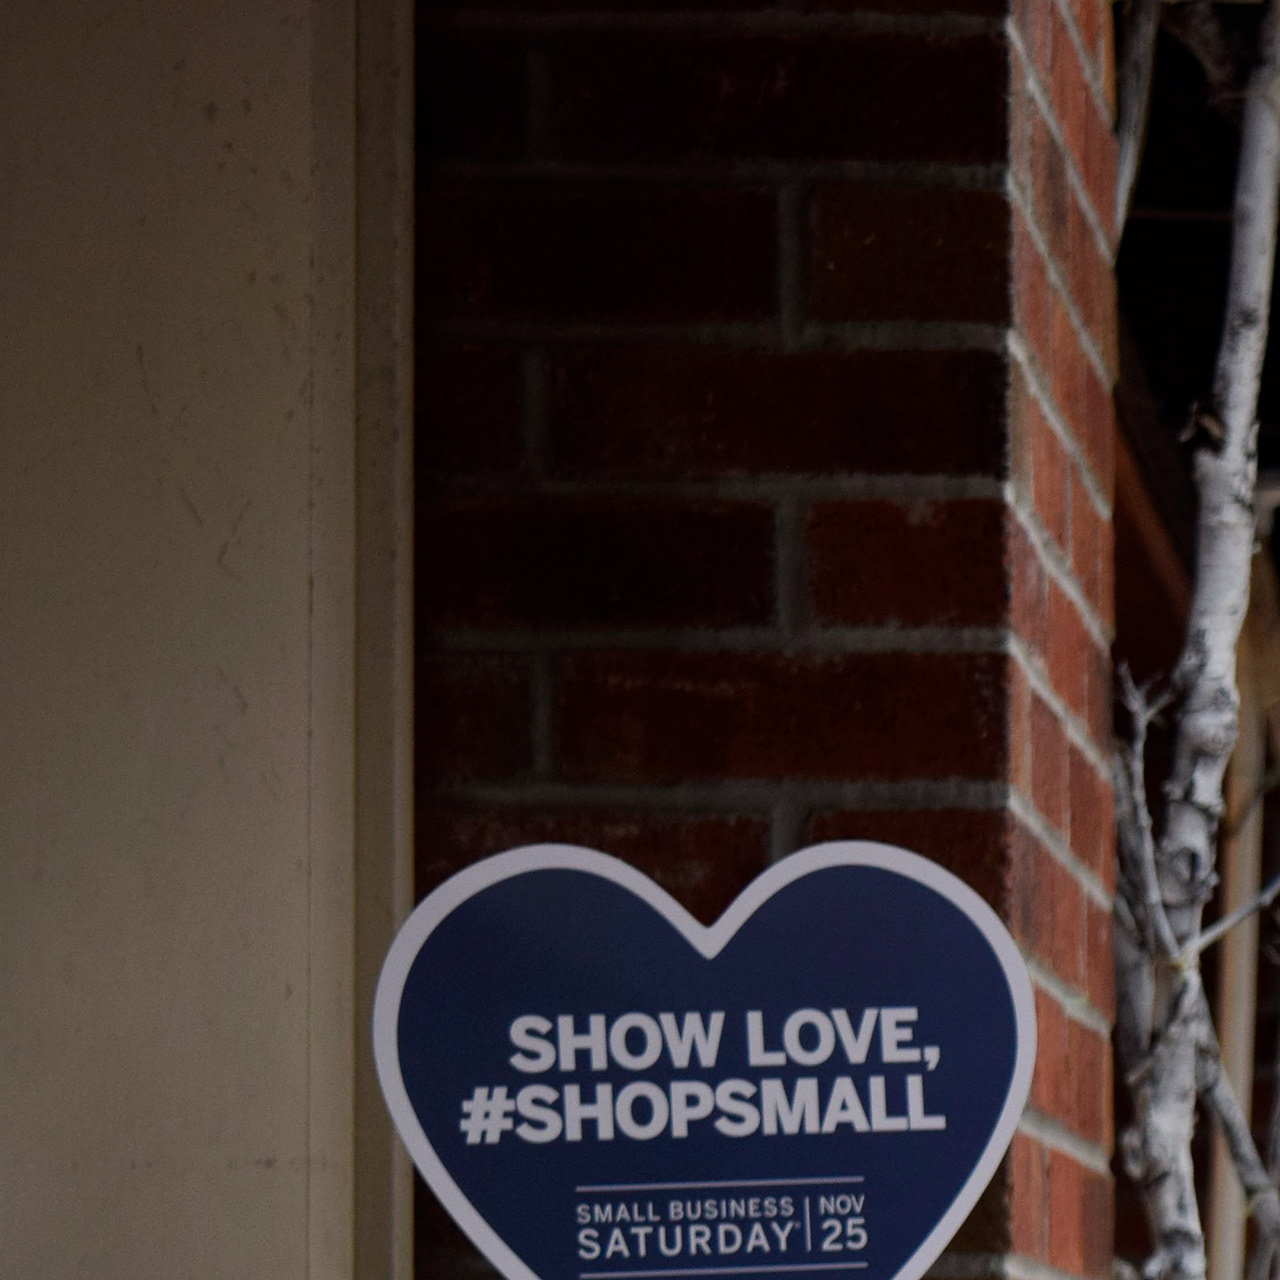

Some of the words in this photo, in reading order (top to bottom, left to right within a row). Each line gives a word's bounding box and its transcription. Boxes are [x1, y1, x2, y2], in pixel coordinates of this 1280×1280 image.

[509, 1011, 725, 1073] SHOW
[746, 1006, 940, 1071] LOVE,
[459, 1074, 946, 1145] #SHOPSMALL
[576, 1202, 662, 1225] SMALL
[668, 1196, 795, 1221] BUSINESS
[818, 1193, 865, 1215] NOV
[577, 1220, 796, 1260] SATURDAY
[821, 1217, 869, 1251] 25
